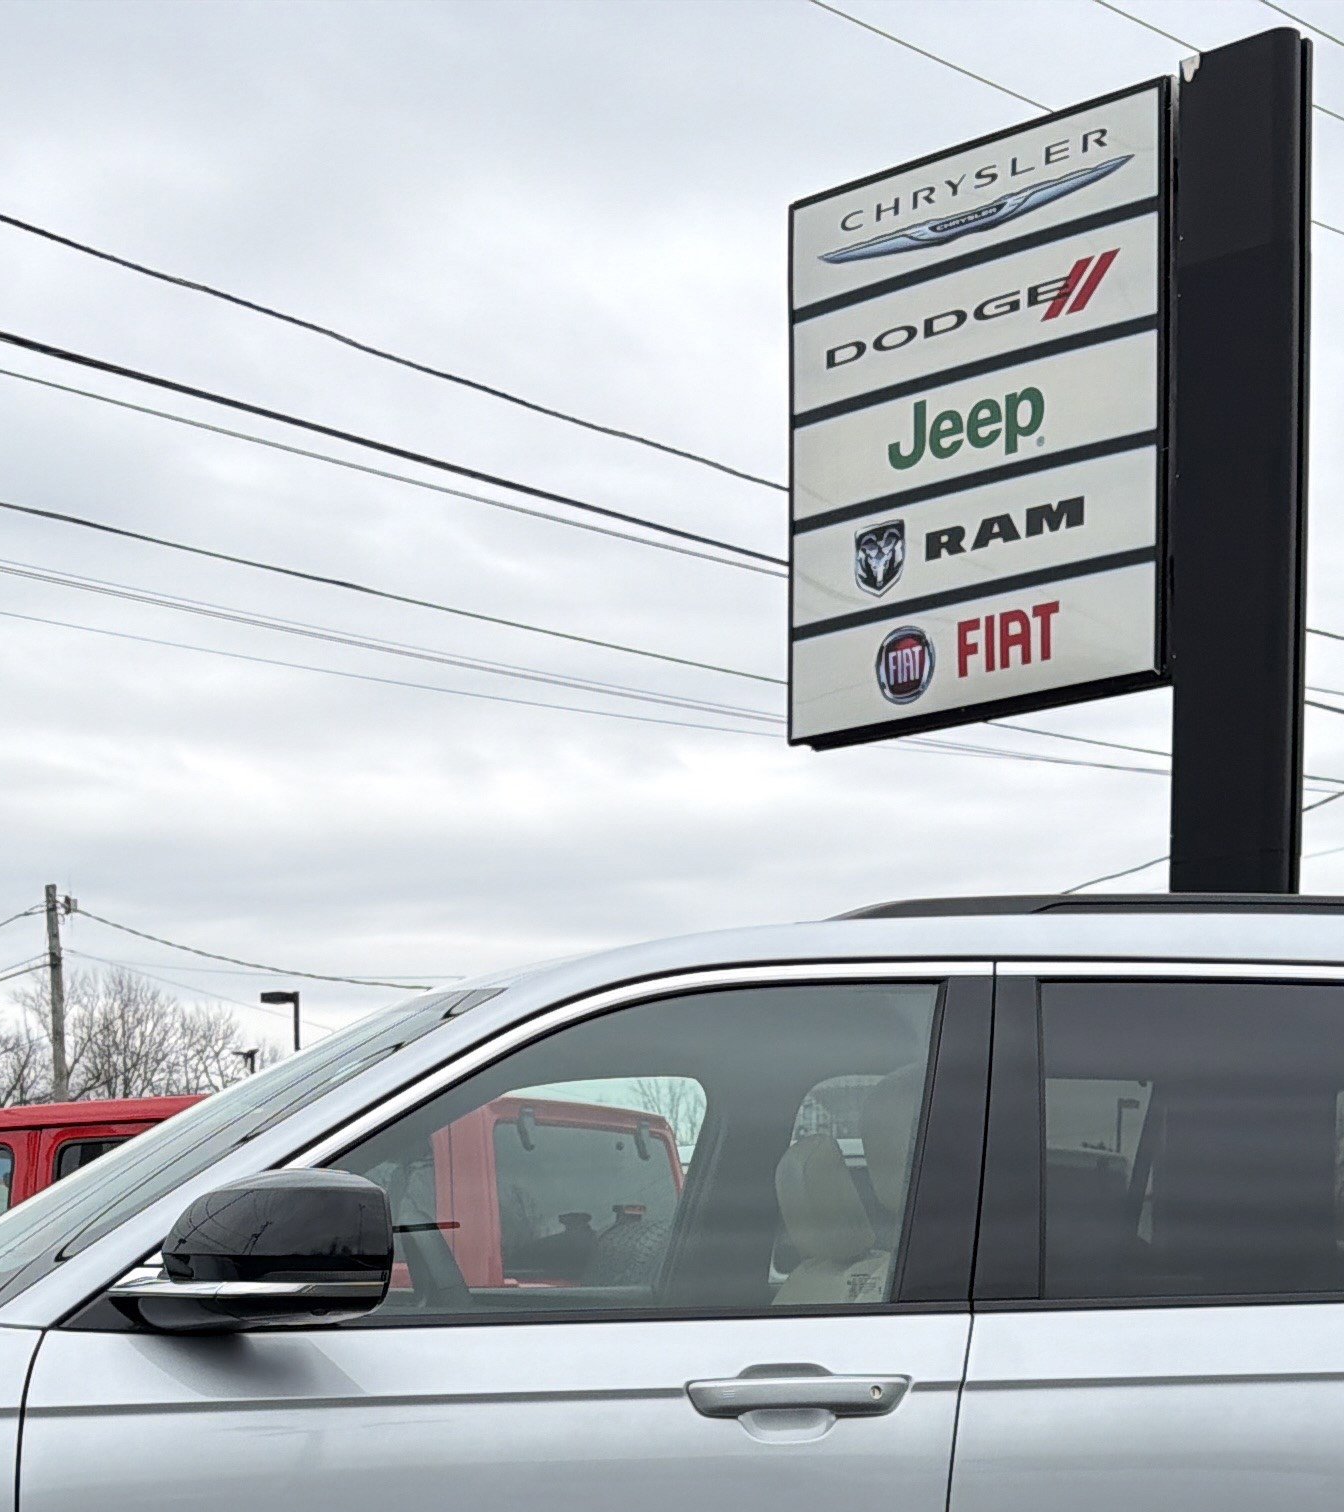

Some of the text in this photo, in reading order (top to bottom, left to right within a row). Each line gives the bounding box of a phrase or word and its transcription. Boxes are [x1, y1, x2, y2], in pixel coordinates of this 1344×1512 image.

[840, 128, 1108, 231] CHRYSLER
[825, 275, 1072, 369] DODGE
[888, 386, 1045, 470] Jeep
[924, 496, 1085, 562] RAM
[888, 645, 923, 686] FIAT
[957, 601, 1060, 678] FIAT
